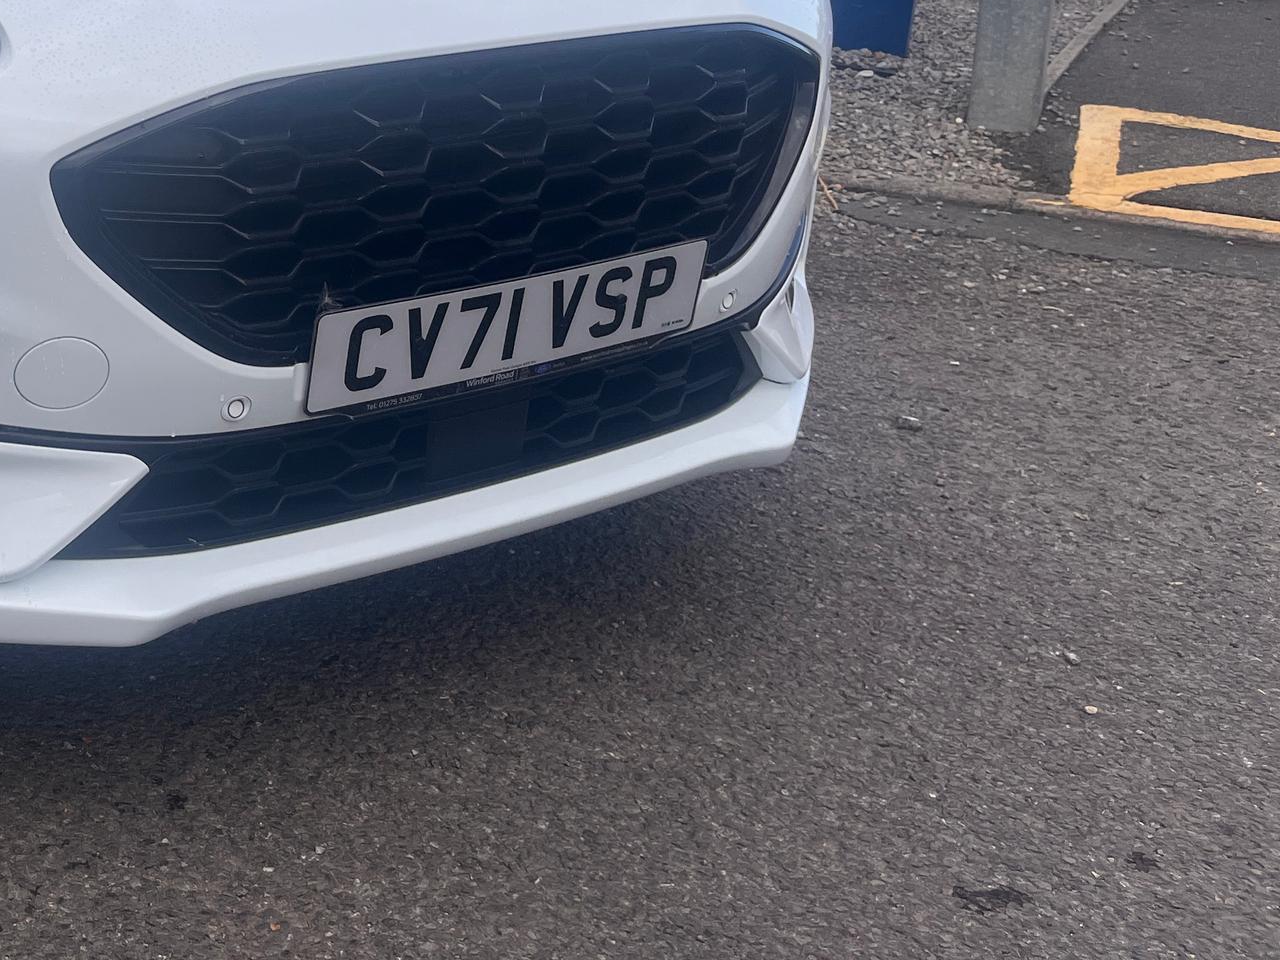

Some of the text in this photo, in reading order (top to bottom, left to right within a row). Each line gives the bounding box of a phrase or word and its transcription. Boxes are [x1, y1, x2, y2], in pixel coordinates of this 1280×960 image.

[343, 255, 678, 392] CV71 VSP
[466, 374, 495, 388] Winford
[495, 370, 516, 383] Road
